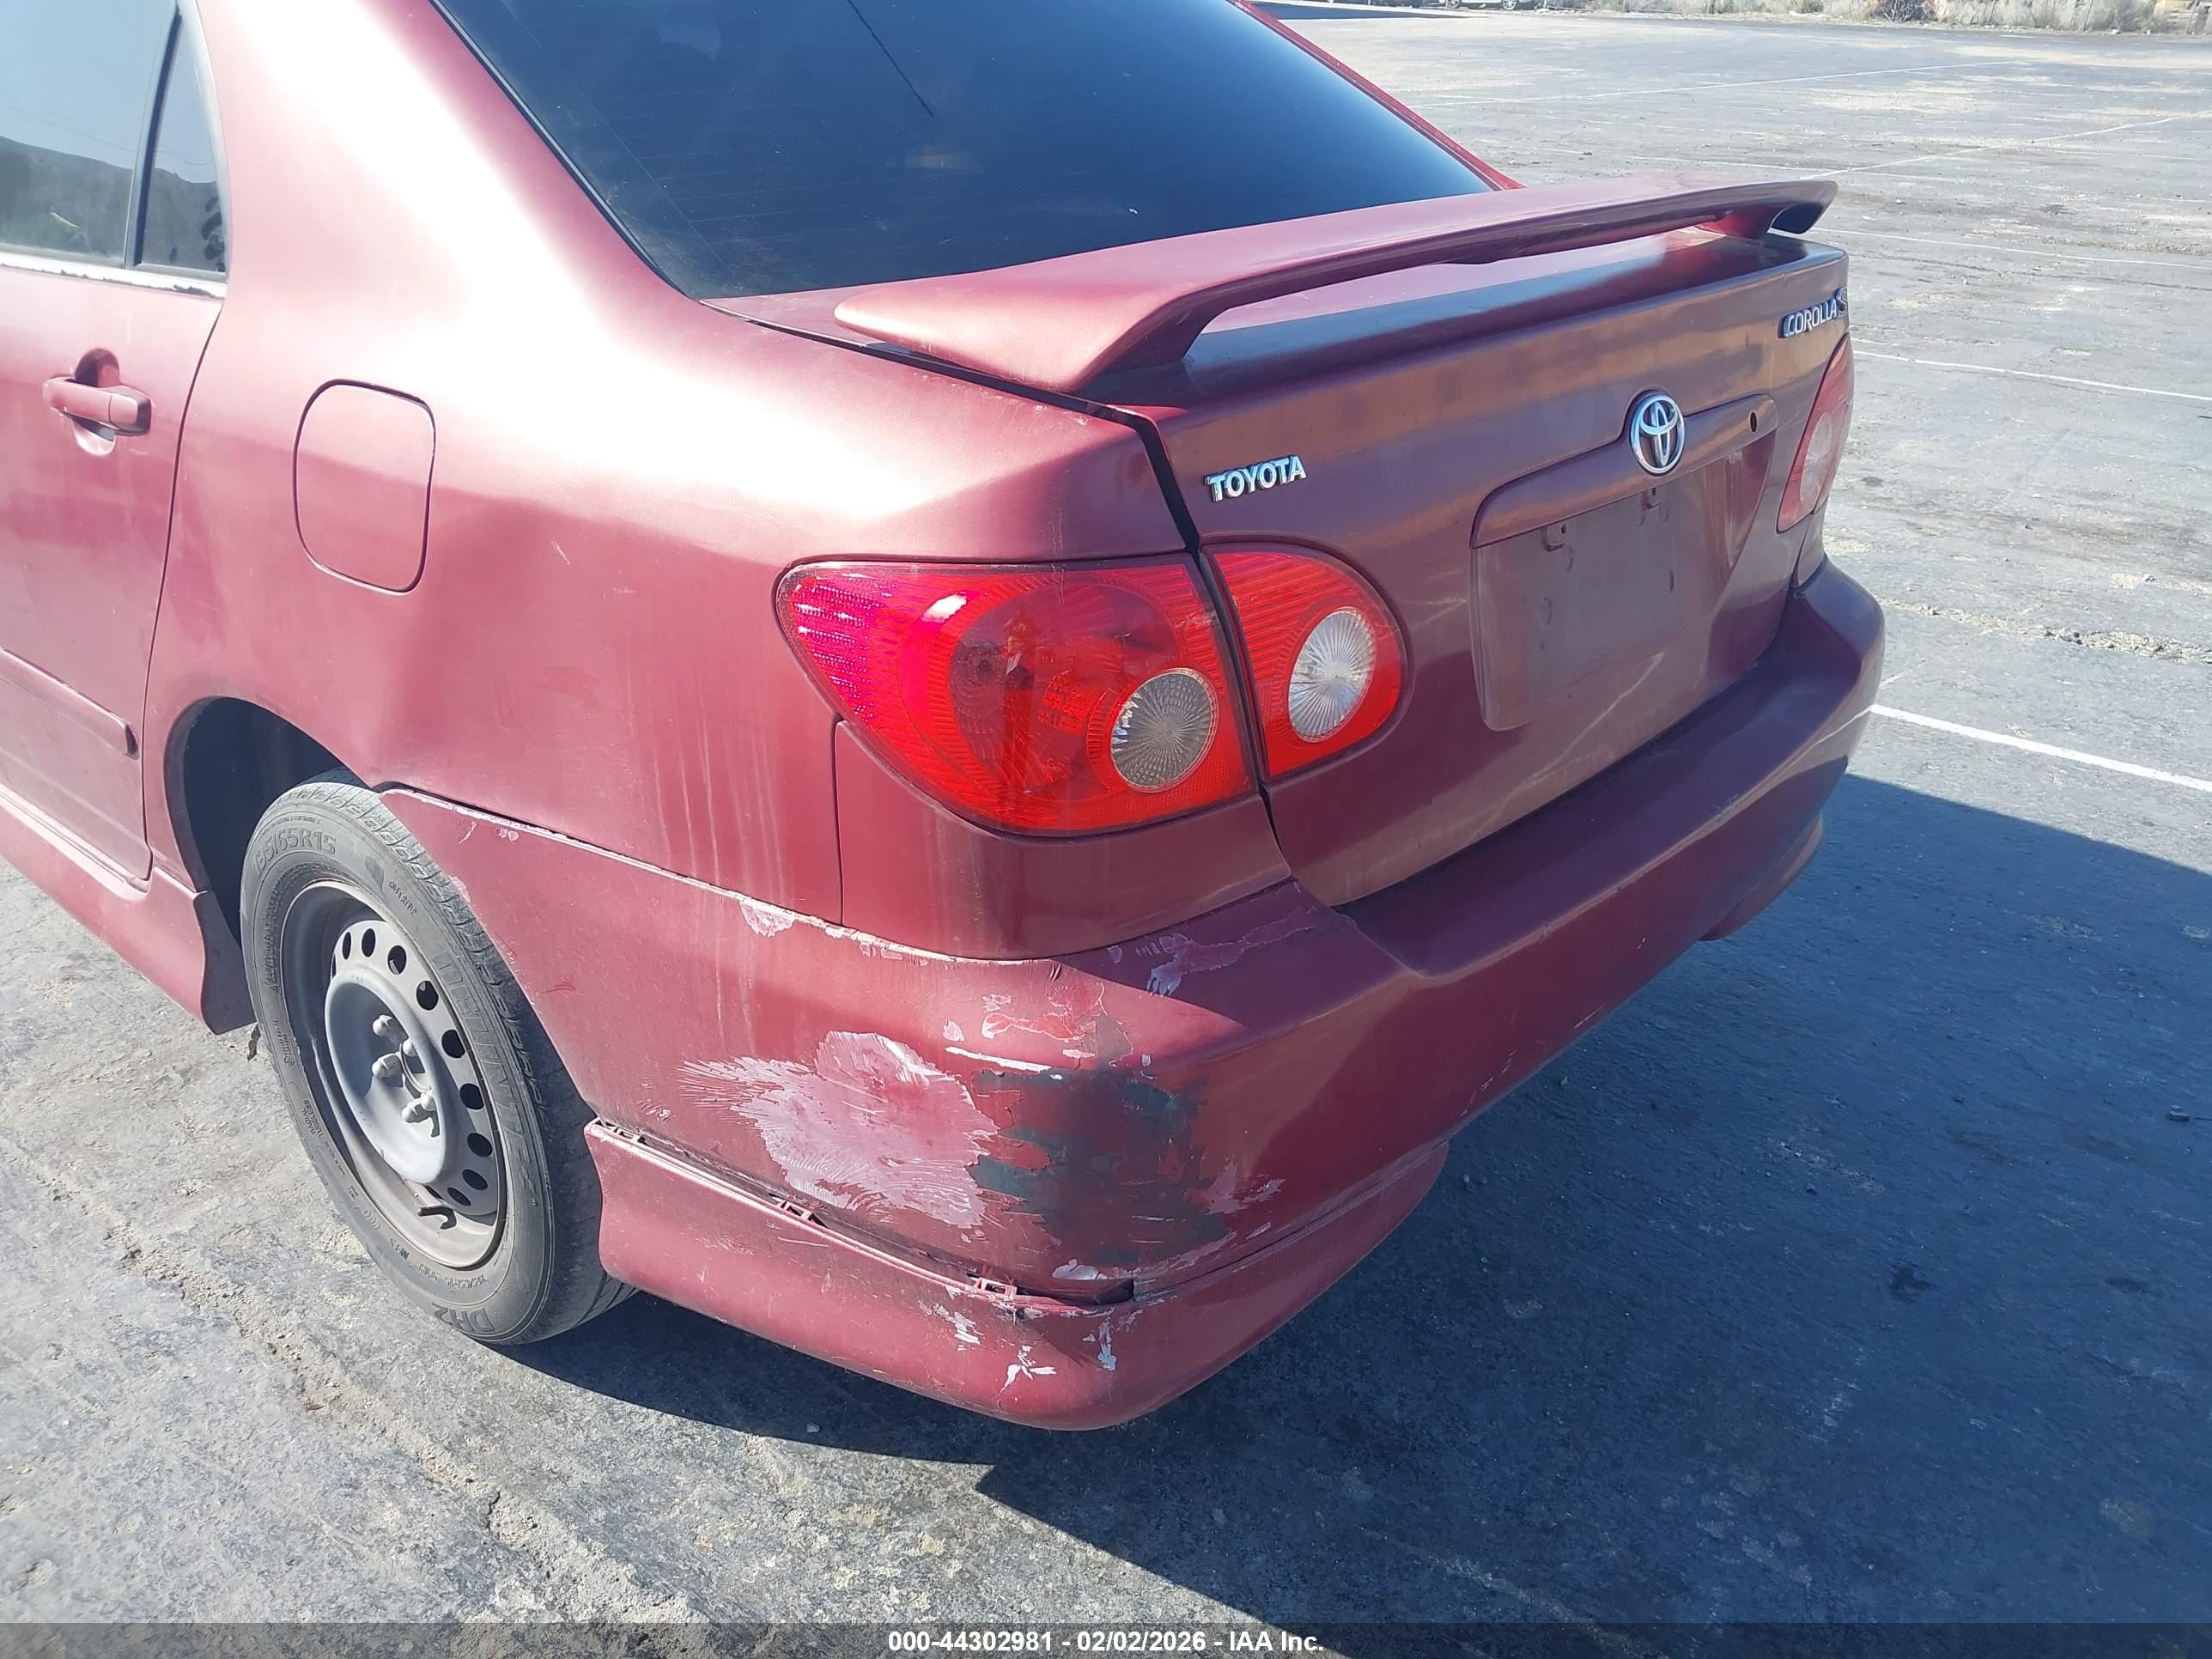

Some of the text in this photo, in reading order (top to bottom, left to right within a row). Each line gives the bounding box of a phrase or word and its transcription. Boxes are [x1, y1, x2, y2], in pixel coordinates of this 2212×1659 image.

[1780, 297, 1838, 337] COROLLA
[1204, 455, 1306, 502] TOYOTA
[254, 827, 337, 877] 195/65R15
[303, 1099, 324, 1139] TUBELESS
[432, 1301, 495, 1331] DH2
